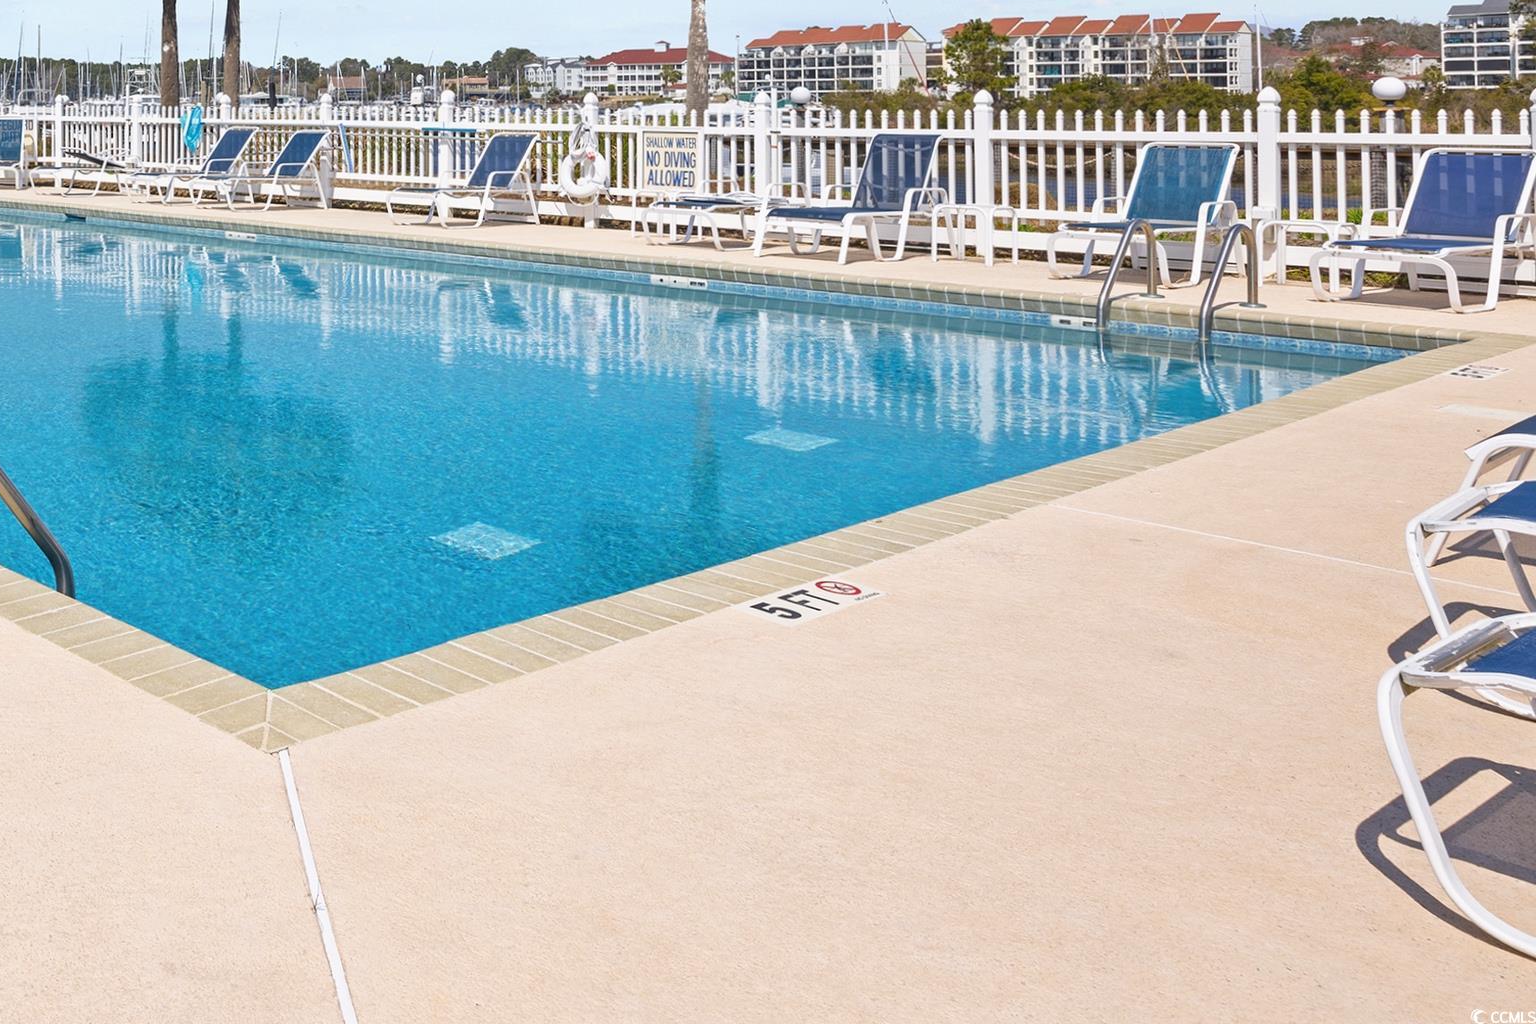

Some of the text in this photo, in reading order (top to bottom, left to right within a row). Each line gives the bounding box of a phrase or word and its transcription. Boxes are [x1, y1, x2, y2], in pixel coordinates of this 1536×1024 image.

[646, 137, 696, 149] SHALLOW WATER
[647, 151, 696, 168] NO DIVING
[647, 169, 695, 187] ALLOWED
[750, 602, 802, 619] 5
[777, 589, 840, 611] FT
